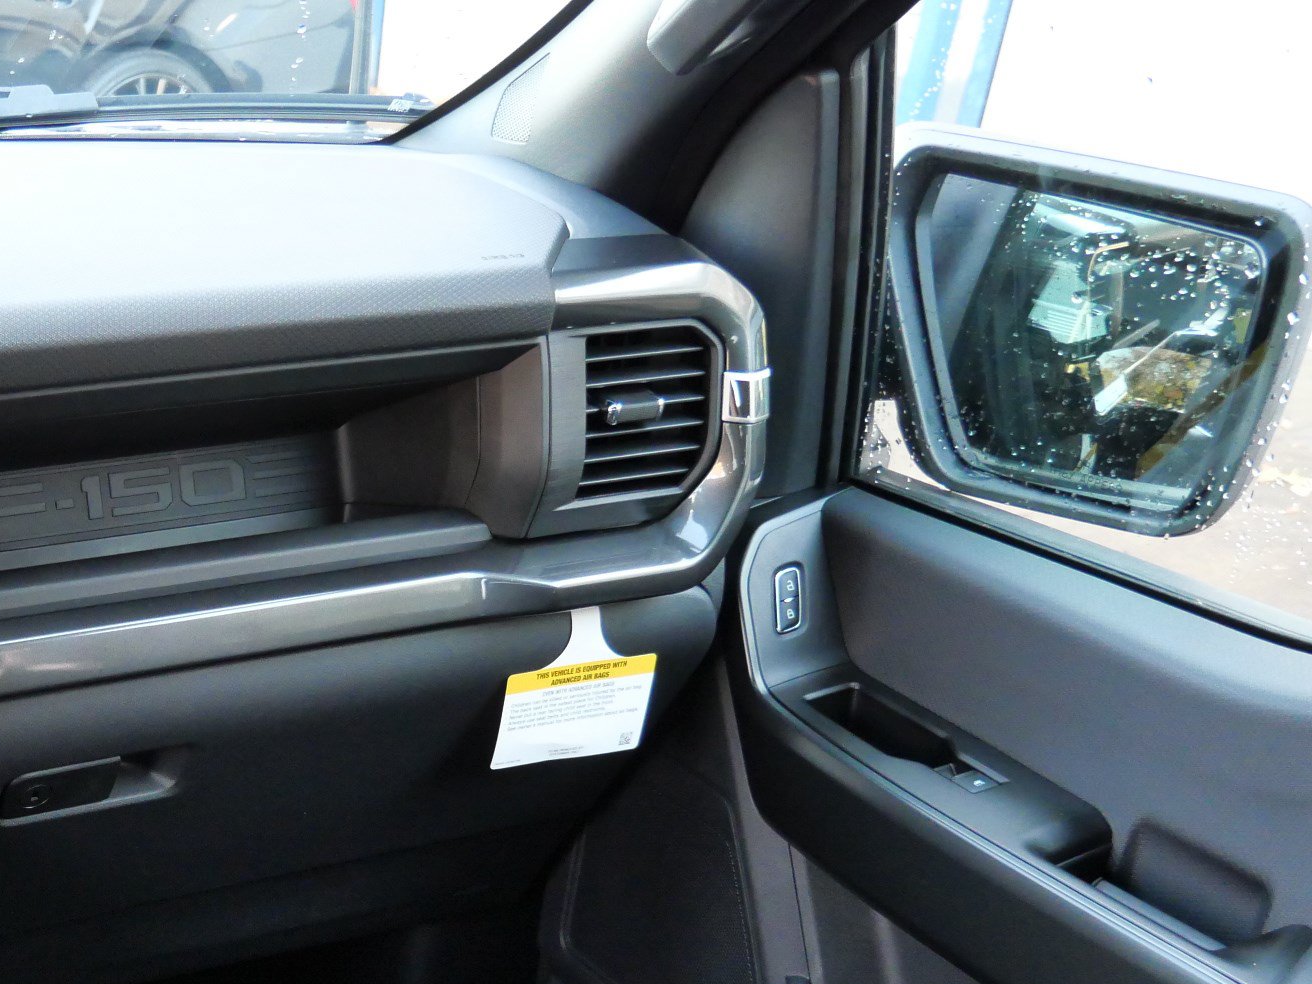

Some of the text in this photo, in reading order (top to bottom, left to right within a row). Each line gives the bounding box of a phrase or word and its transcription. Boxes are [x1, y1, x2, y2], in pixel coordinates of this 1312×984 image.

[536, 660, 628, 680] THIS VEHICLE IS EQUIPPED WITH
[550, 676, 582, 687] ADVANCED
[593, 672, 610, 680] BAGS
